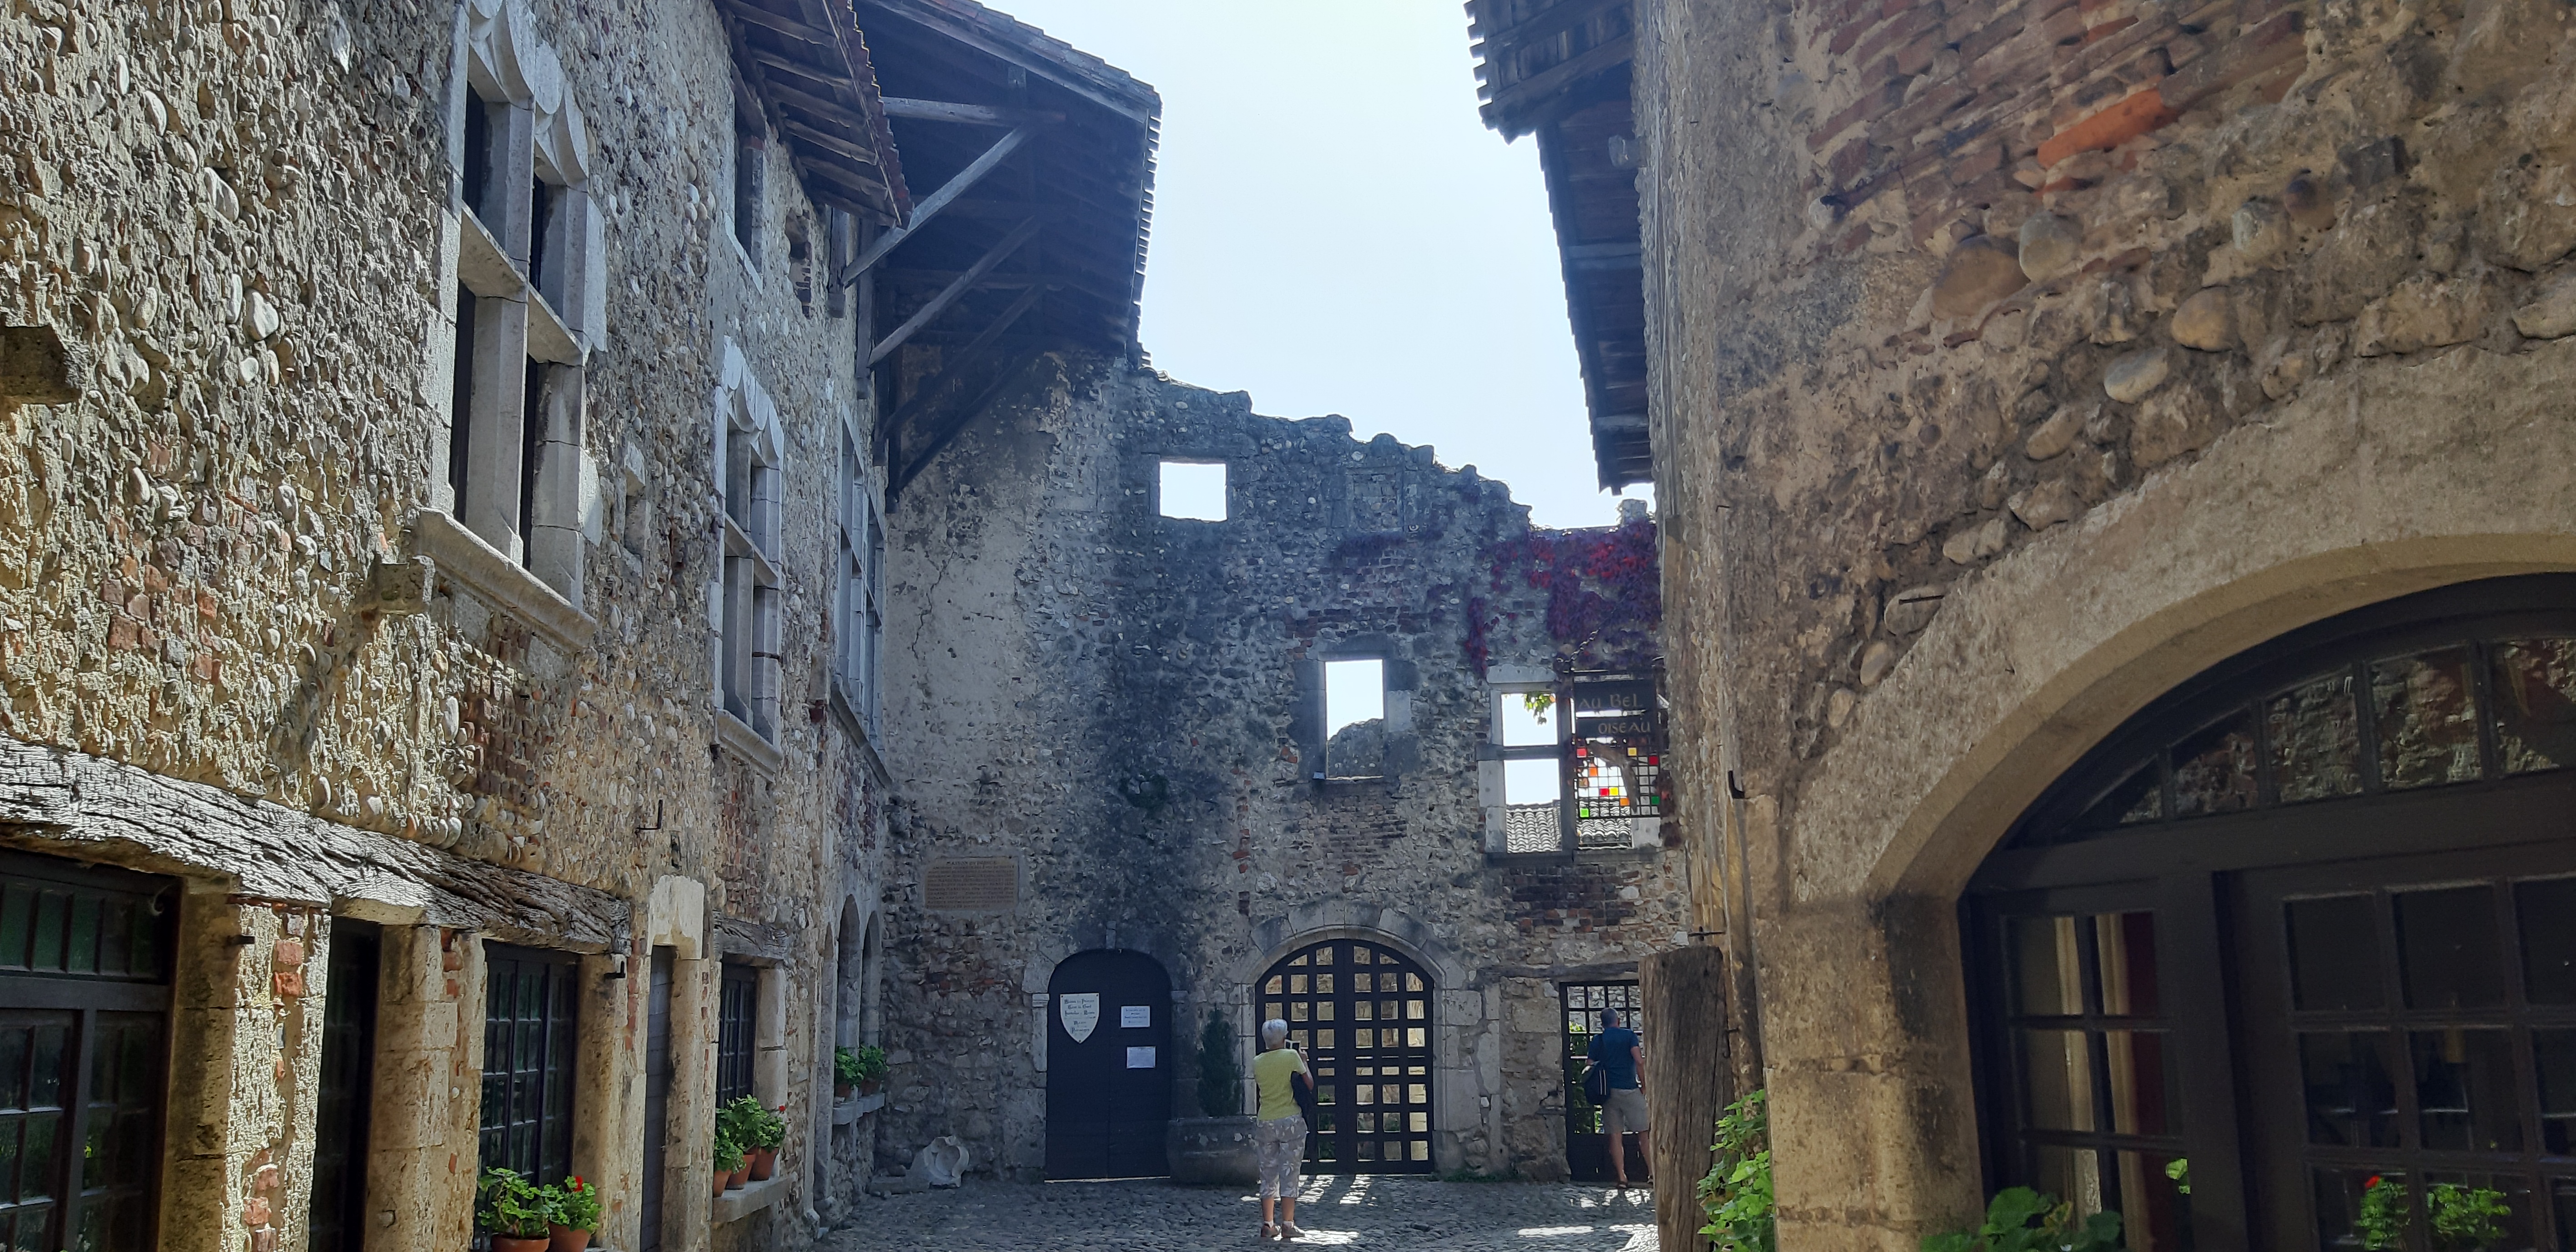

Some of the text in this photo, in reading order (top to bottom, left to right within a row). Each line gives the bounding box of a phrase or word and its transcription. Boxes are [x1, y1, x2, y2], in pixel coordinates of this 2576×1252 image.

[1579, 694, 1643, 709] AU BEL
[1598, 721, 1651, 735] OISEAU
